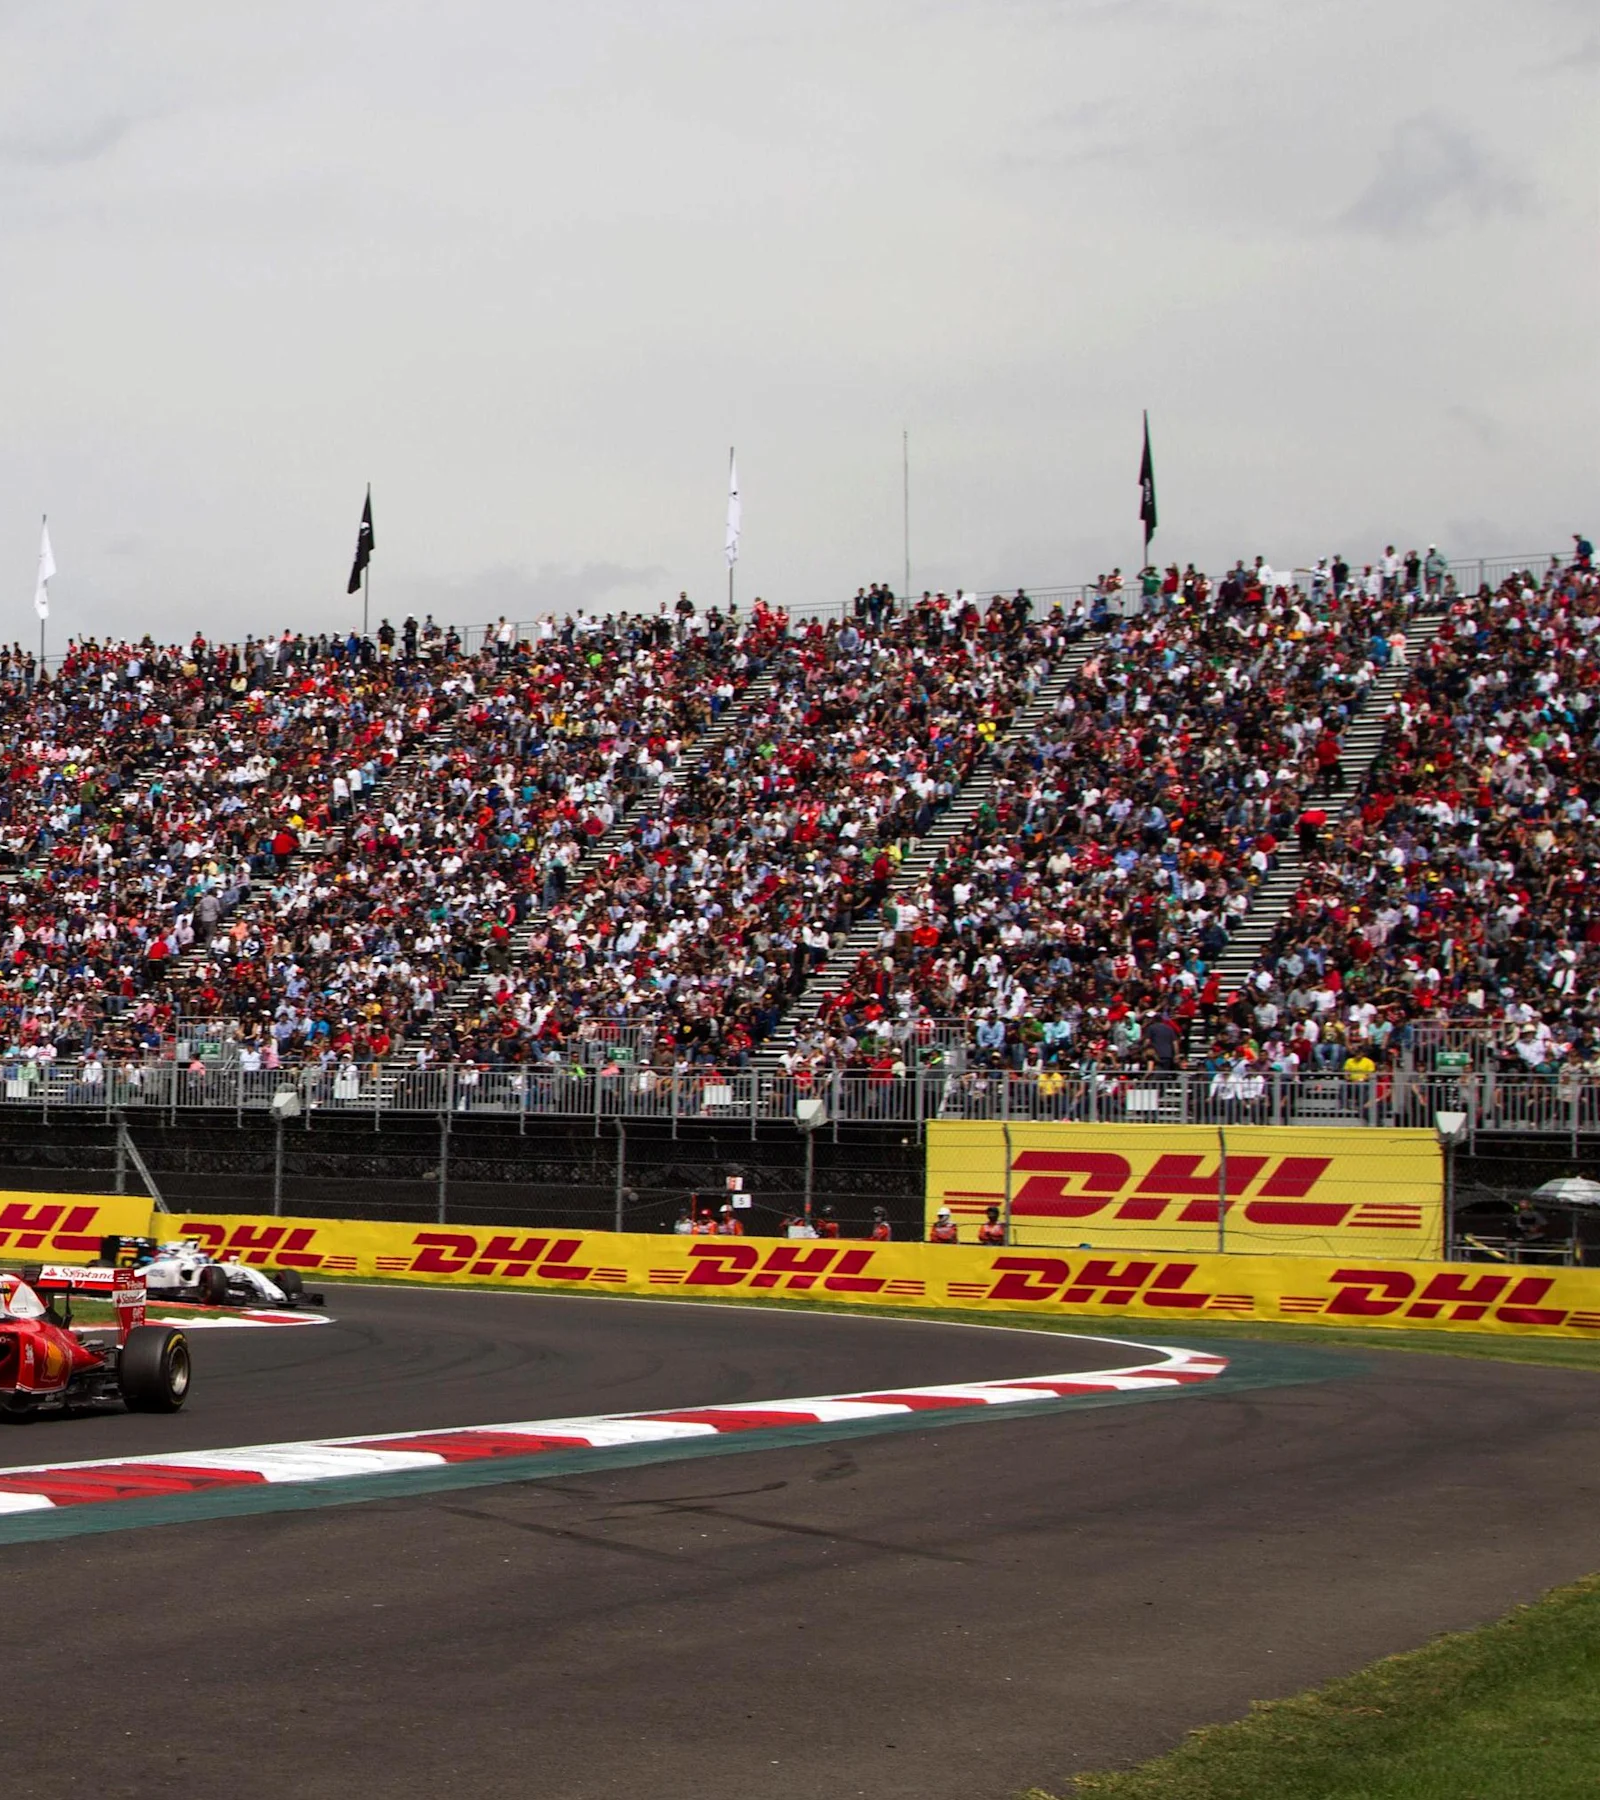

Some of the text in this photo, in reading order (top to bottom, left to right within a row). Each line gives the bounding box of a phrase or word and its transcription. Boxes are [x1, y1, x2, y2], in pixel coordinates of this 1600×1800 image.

[1008, 1151, 1354, 1227] DHL
[179, 1222, 324, 1268] DHL
[410, 1232, 594, 1281] DHL
[685, 1243, 887, 1293] DHL
[988, 1256, 1211, 1309] DHL
[1324, 1268, 1569, 1326] DHL
